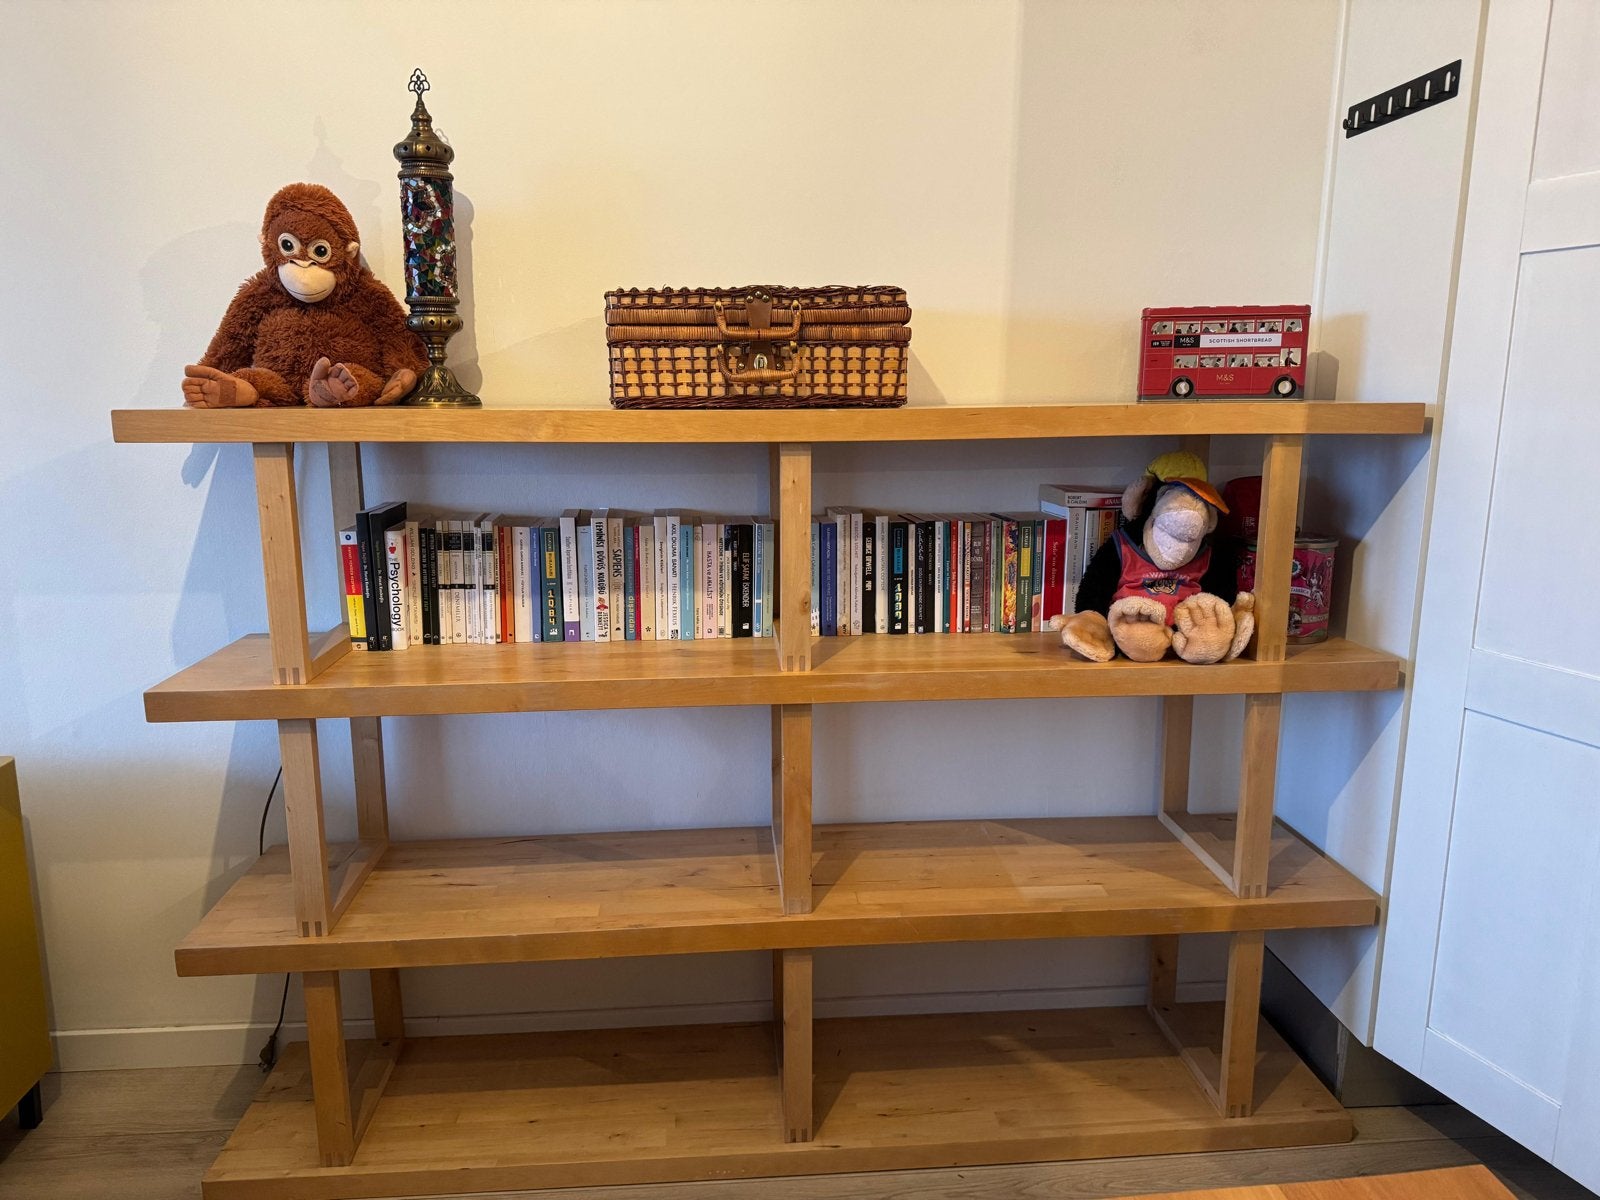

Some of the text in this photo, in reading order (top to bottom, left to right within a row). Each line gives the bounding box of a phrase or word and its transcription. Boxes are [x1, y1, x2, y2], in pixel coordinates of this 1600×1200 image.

[1216, 374, 1234, 382] M&S
[595, 522, 607, 595] FEMİNİST DÖVÜŞ KULÜBÜ
[612, 548, 622, 578] SAPIENS
[741, 552, 751, 608] ELİF ŞAFAK İSKENDER
[389, 562, 402, 627] Psychology
